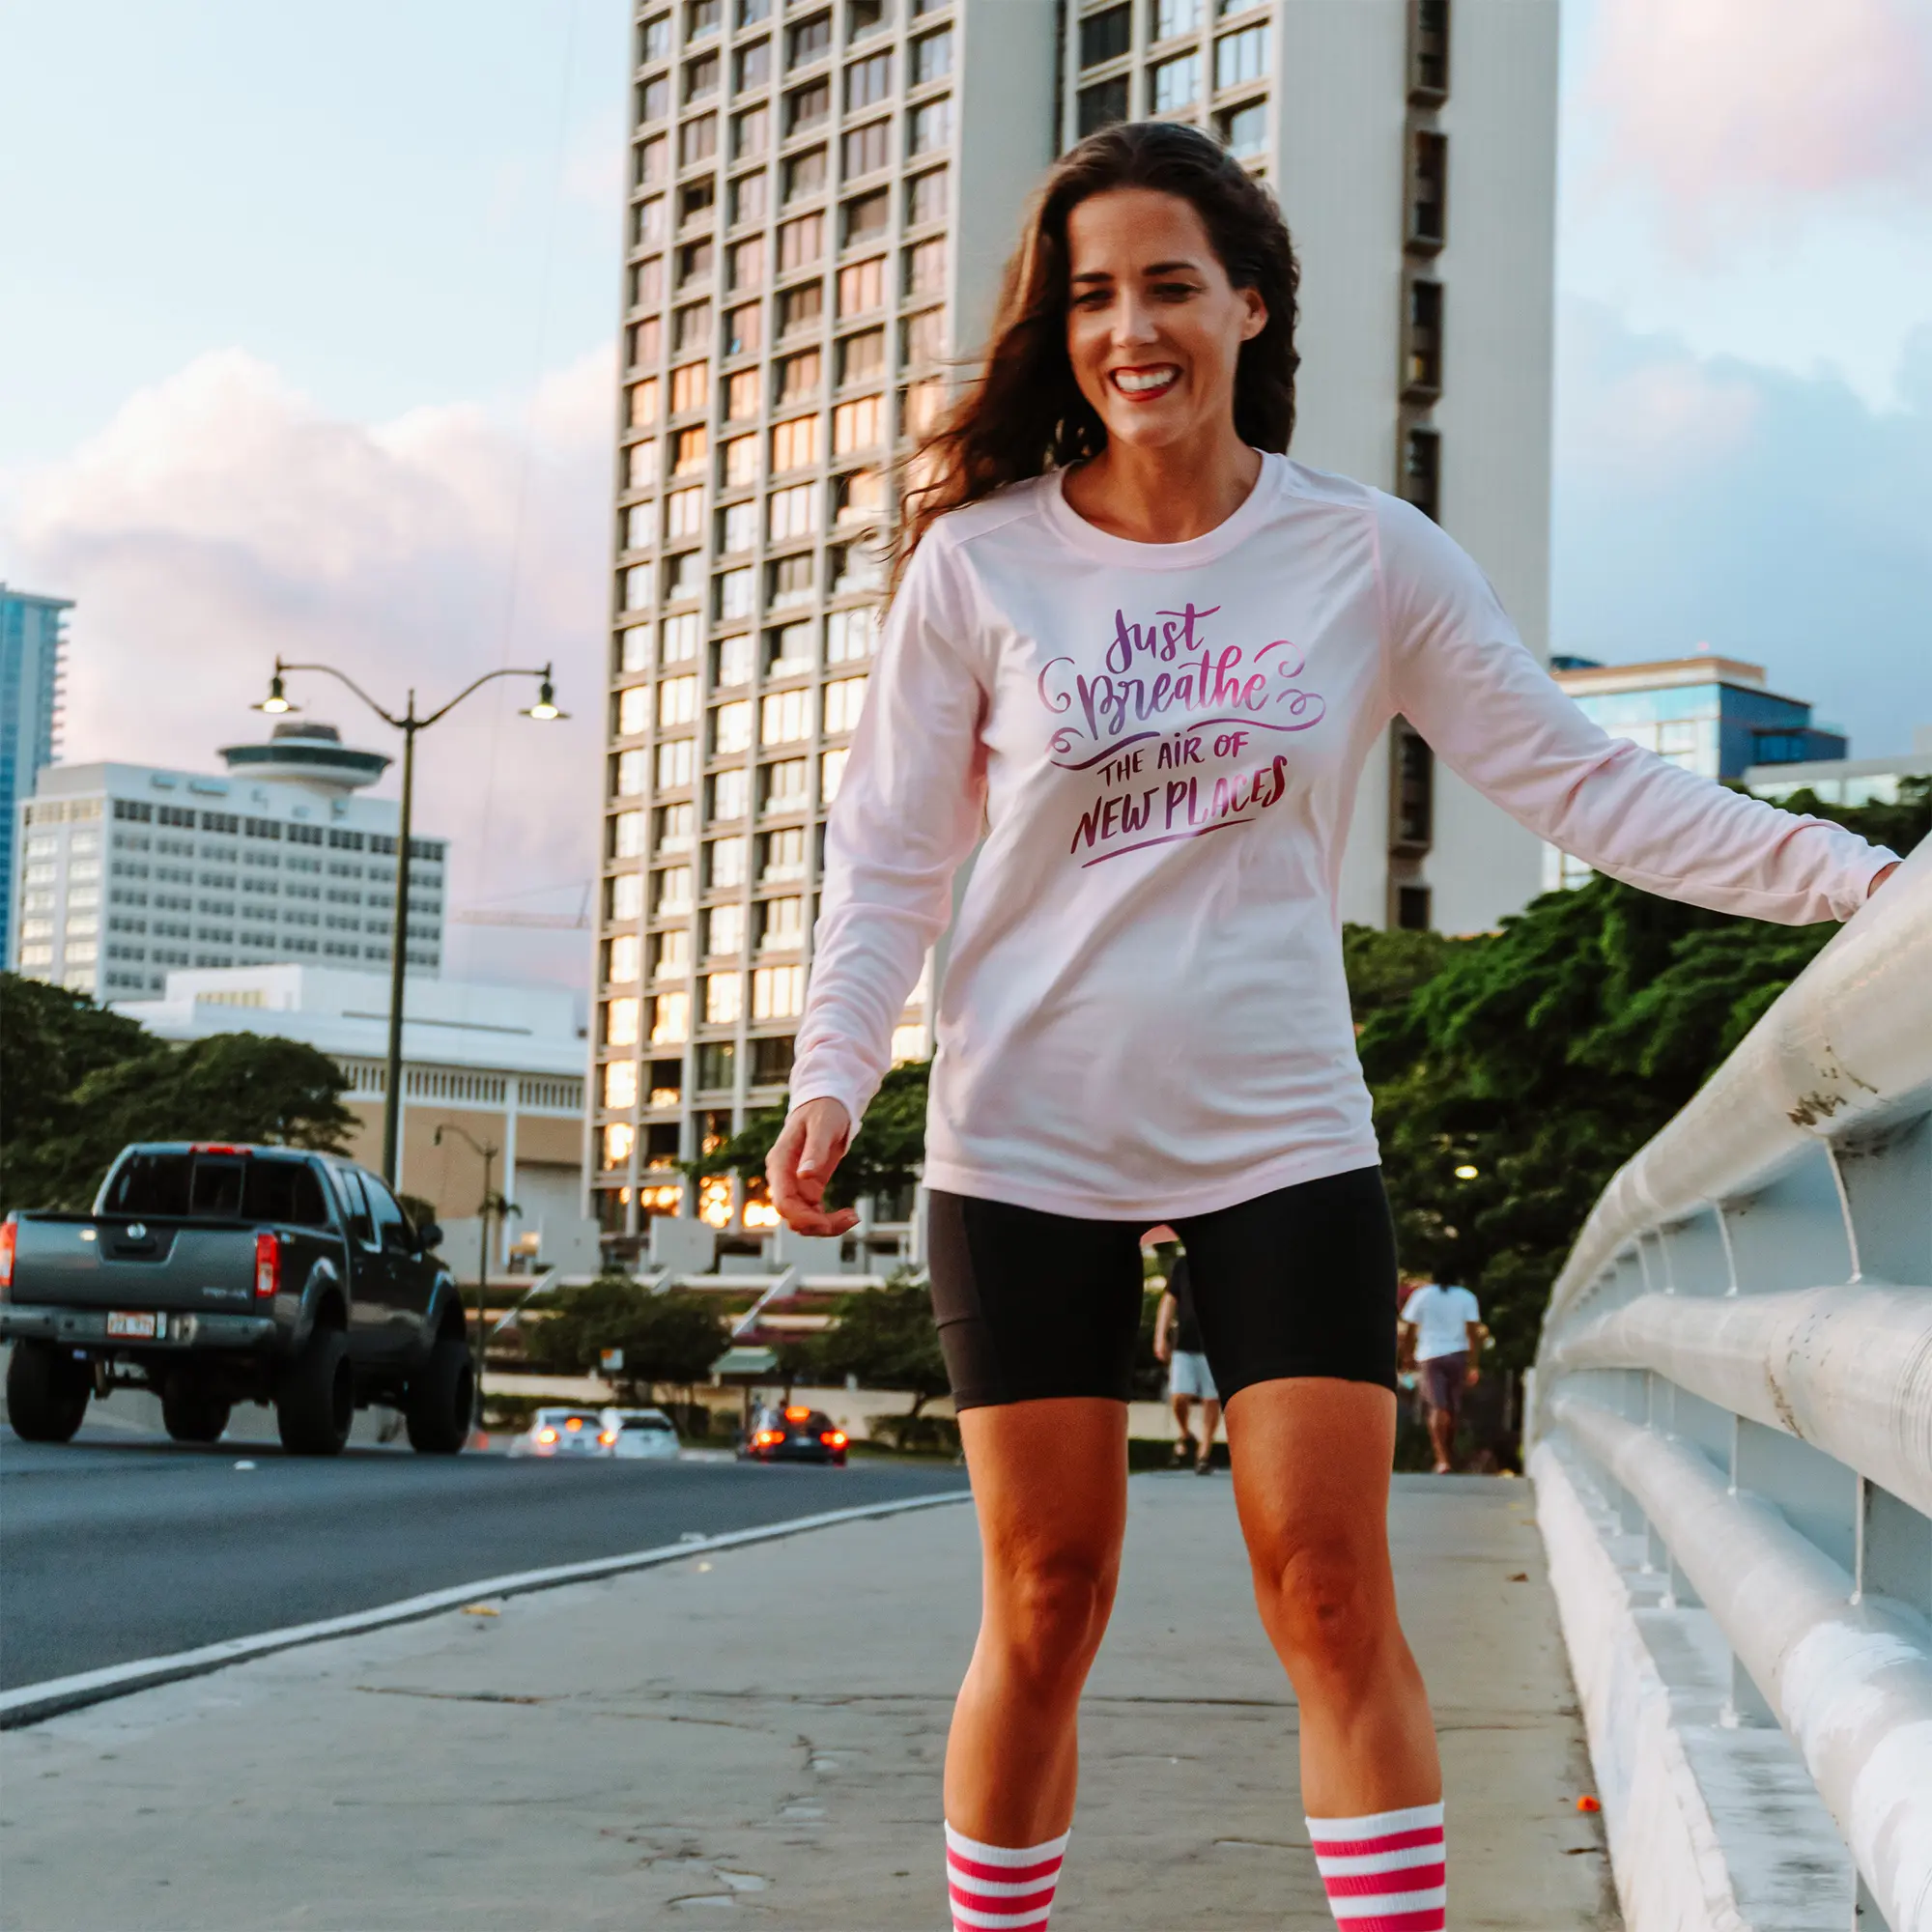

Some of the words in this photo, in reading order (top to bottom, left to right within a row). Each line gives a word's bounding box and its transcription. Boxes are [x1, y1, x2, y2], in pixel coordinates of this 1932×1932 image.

[1097, 749, 1145, 786] THE
[1213, 731, 1249, 758] OF
[1070, 787, 1159, 855] NEW
[1165, 755, 1288, 830] PLACES
